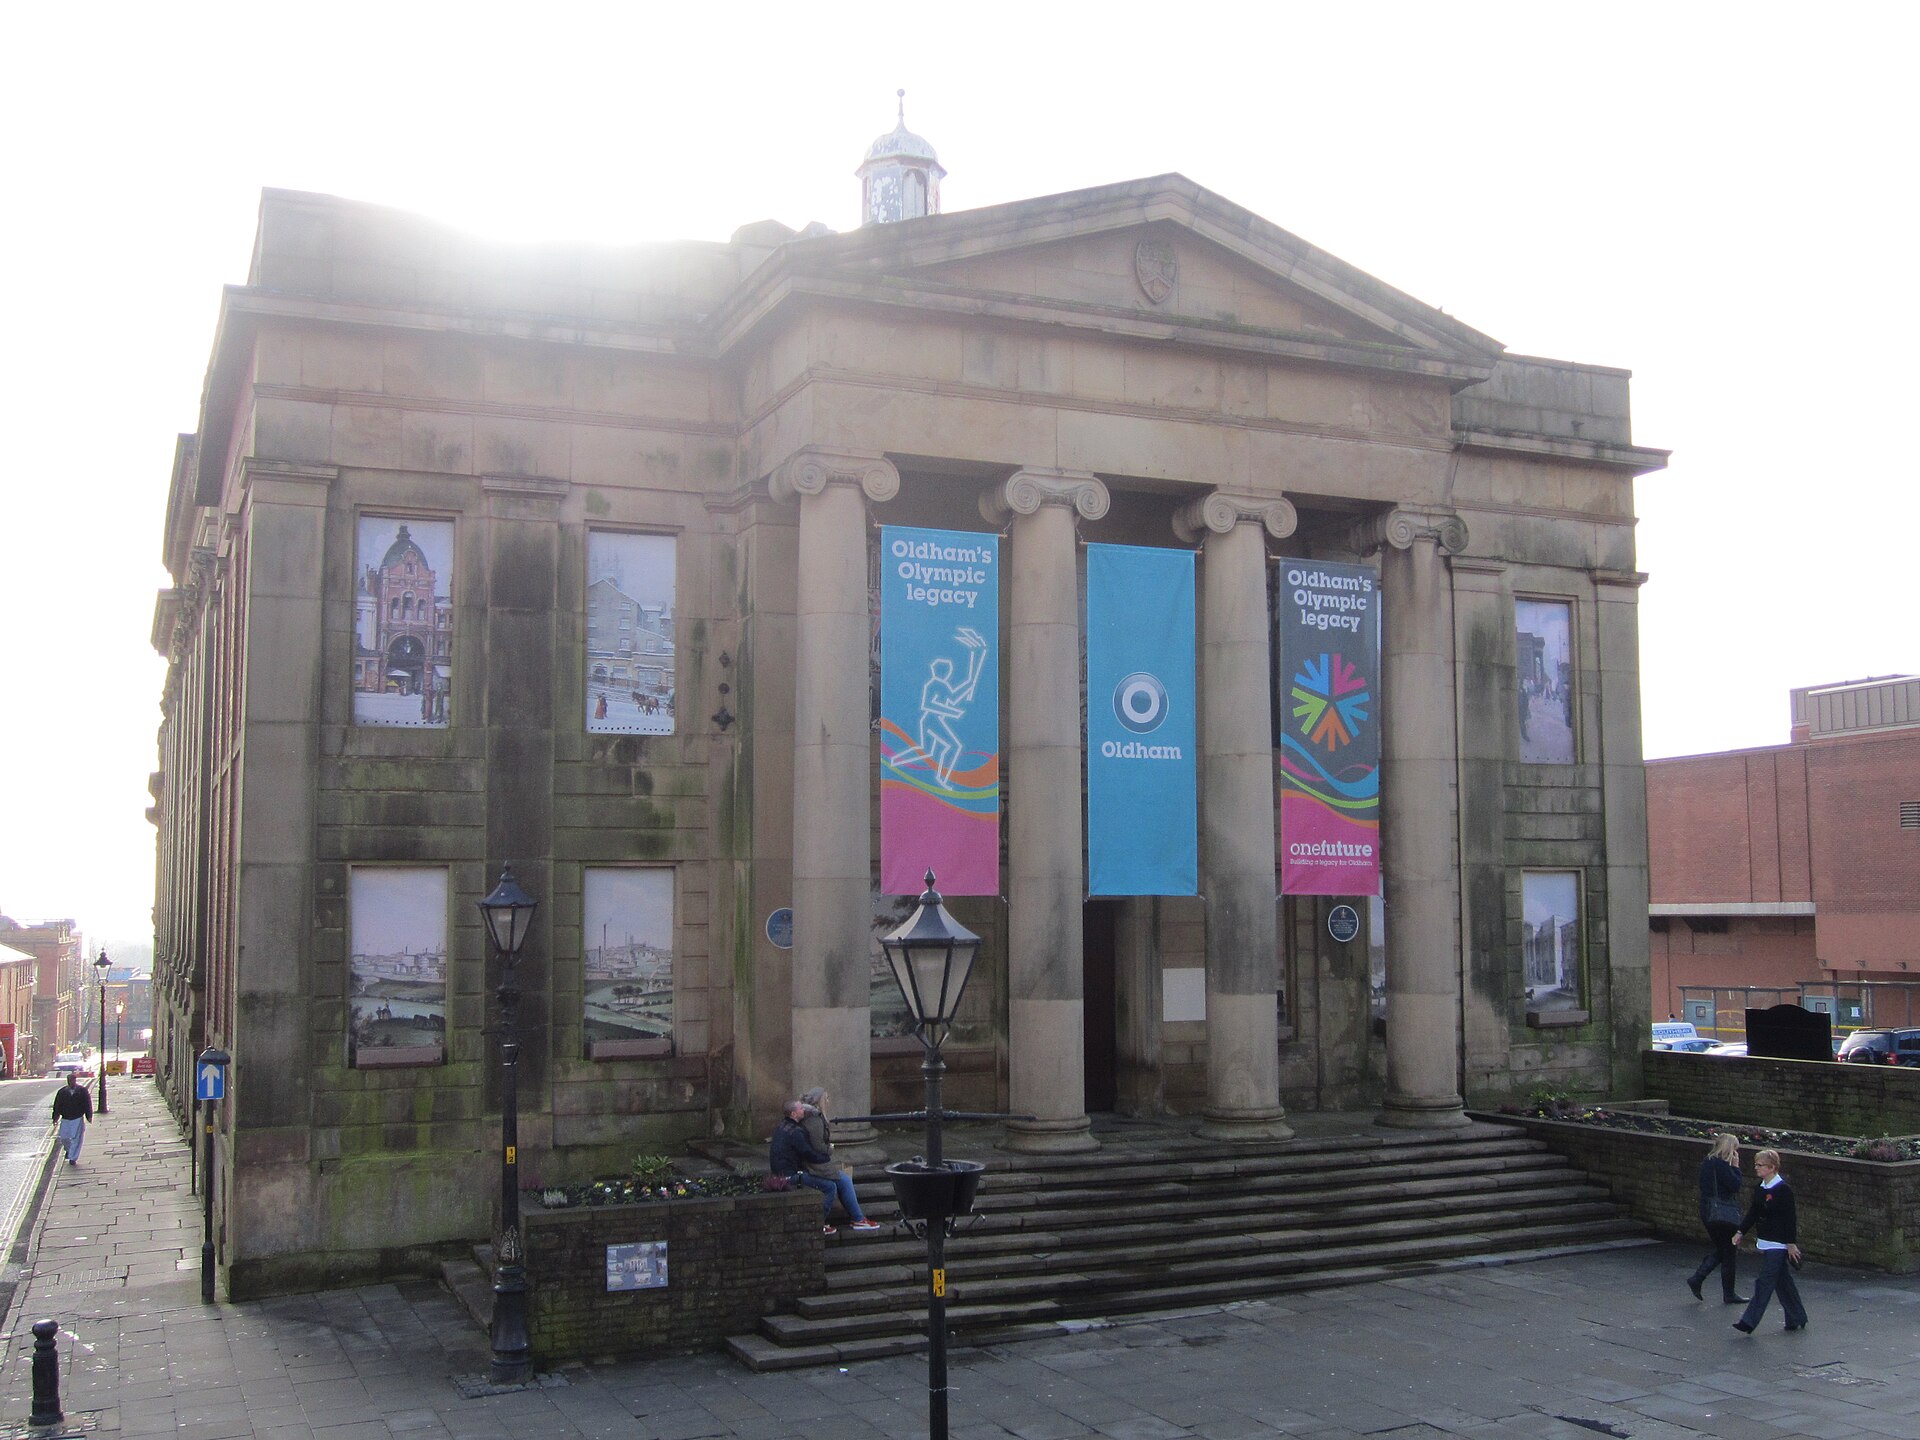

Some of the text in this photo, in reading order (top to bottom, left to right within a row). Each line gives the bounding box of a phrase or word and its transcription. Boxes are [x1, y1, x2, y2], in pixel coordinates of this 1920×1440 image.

[892, 540, 992, 564] Oldham's
[898, 562, 986, 586] Olympic
[1288, 569, 1372, 592] Oldham's
[907, 584, 978, 608] legacy
[1294, 589, 1367, 612] Olympic
[1301, 609, 1360, 632] legacy
[1101, 741, 1182, 760] Oldham
[1290, 840, 1373, 856] onefuture
[1319, 859, 1338, 867] legacy
[1348, 859, 1372, 867] Oldham
